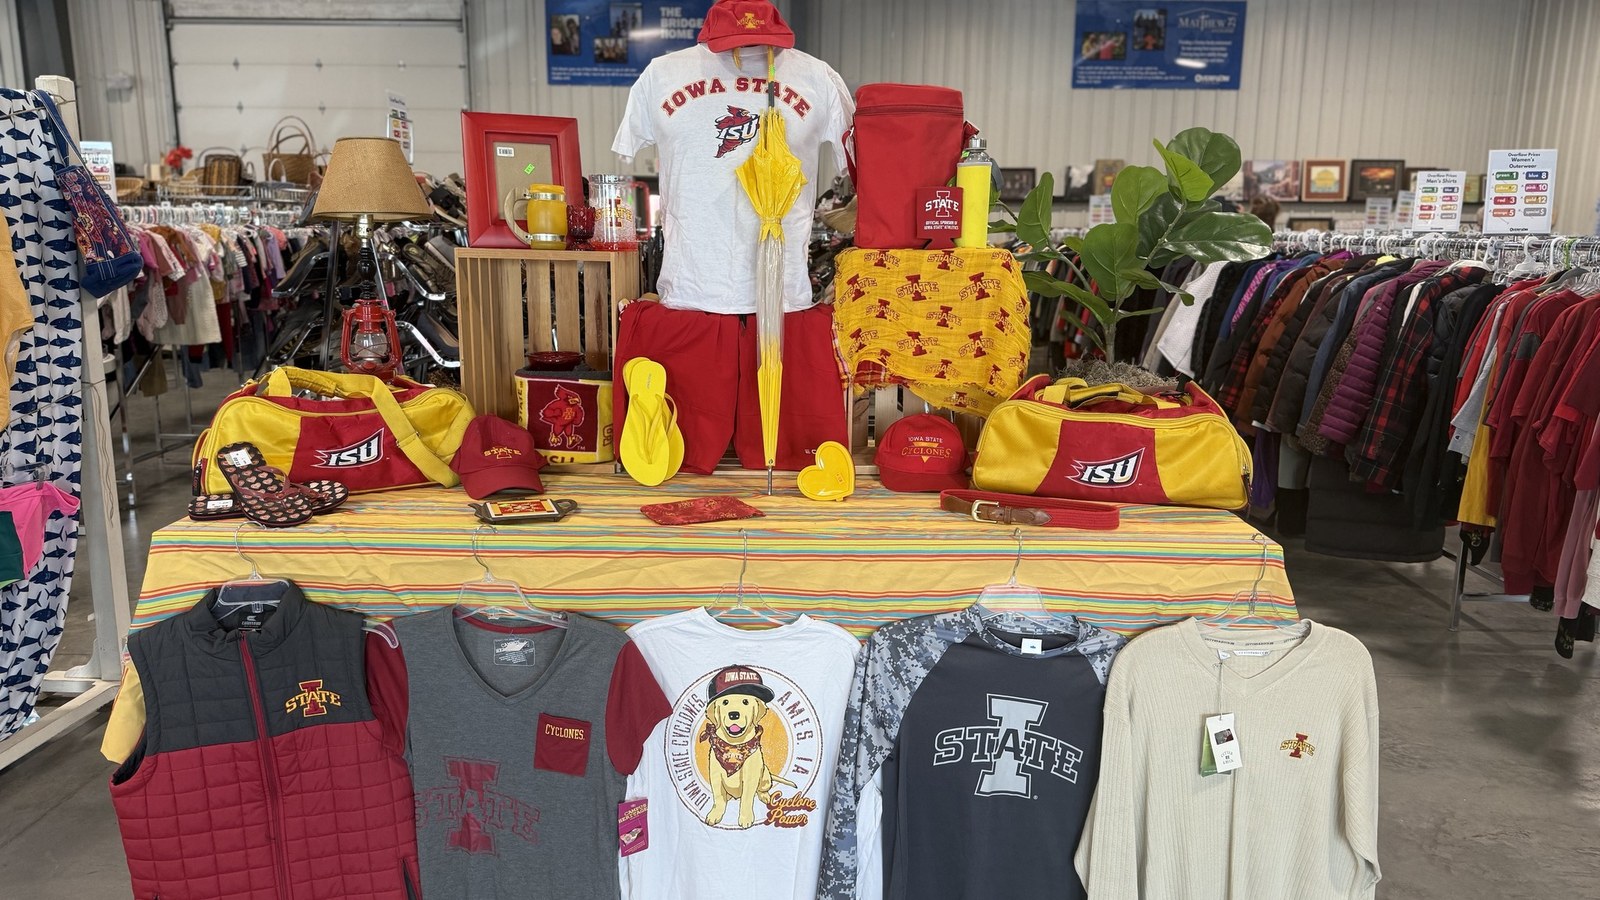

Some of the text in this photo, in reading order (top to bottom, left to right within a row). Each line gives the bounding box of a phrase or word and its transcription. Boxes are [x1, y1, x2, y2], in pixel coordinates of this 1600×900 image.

[660, 7, 682, 17] THE
[660, 18, 704, 28] BRIDGE
[660, 29, 694, 39] HOME
[660, 76, 813, 120] IOWA STATE
[718, 119, 761, 141] ISU
[925, 199, 959, 212] STATE
[896, 281, 939, 298] STATE
[959, 278, 1001, 301] STATE
[328, 437, 379, 467] ISU
[484, 447, 522, 457] STATE
[901, 446, 952, 458] CYCLONES
[1081, 455, 1137, 484] ISU
[725, 671, 758, 683] IOWA STATE
[285, 690, 342, 714] STATE
[545, 723, 585, 740] CYCLONES
[672, 693, 711, 811] IOWA STATE CYCLONES
[933, 726, 1083, 784] STATE
[1280, 739, 1315, 757] STATE
[792, 757, 812, 775] IA
[769, 790, 817, 811] Cyclone
[415, 785, 541, 845] STATE
[766, 808, 810, 827] Power
